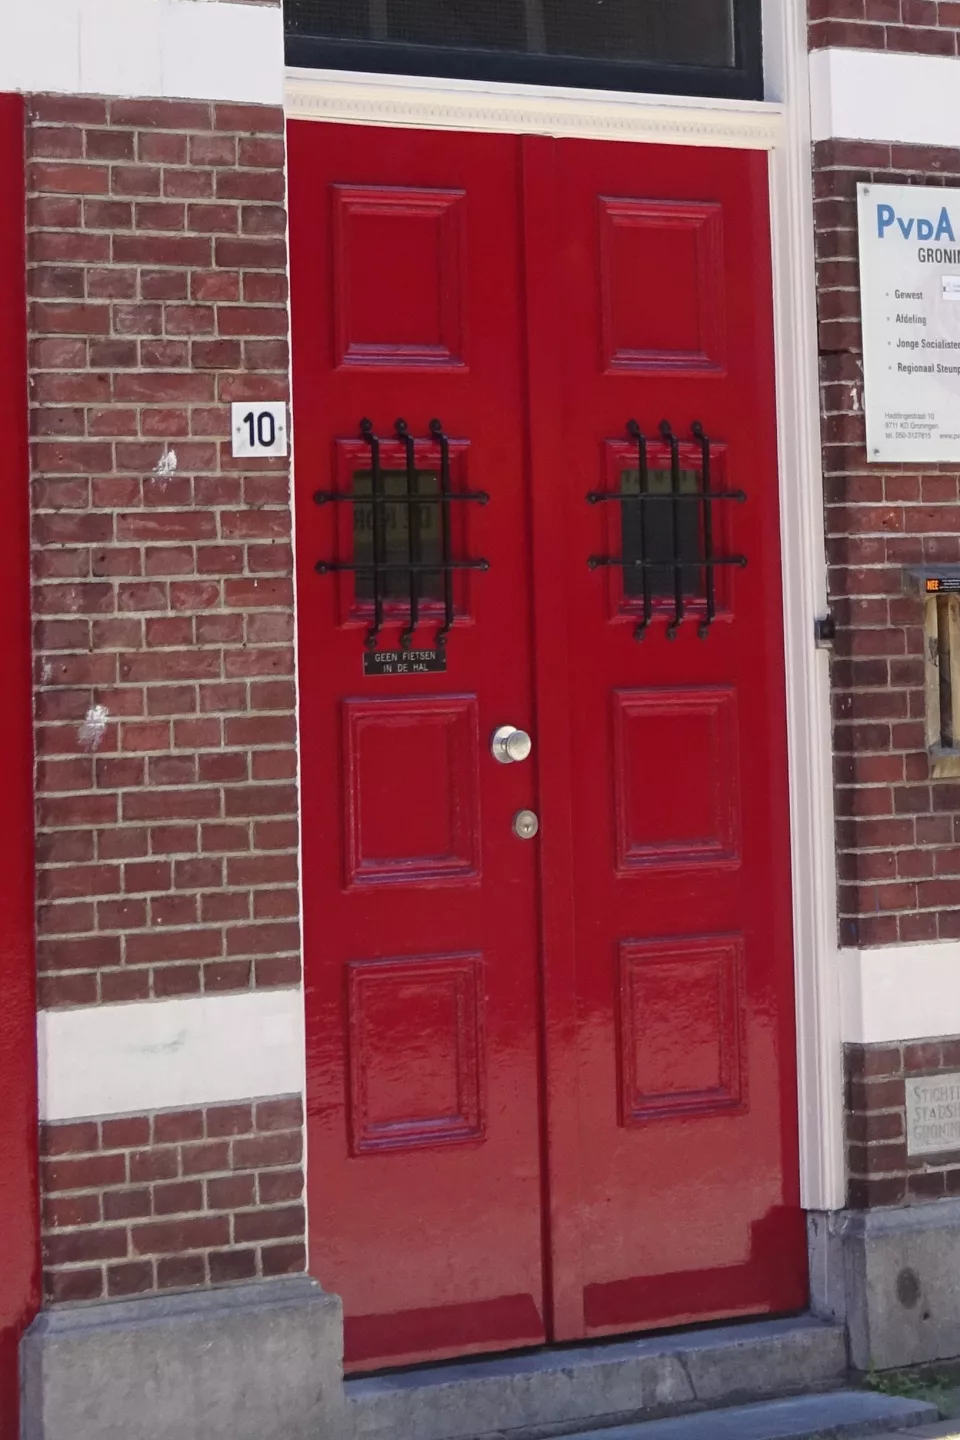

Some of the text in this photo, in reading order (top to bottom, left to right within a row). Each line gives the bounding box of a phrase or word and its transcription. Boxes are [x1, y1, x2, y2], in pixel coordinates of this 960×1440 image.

[895, 290, 923, 300] Gewest
[896, 314, 926, 326] Afdeling
[897, 339, 919, 350] Jonge
[898, 364, 934, 375] Regionaal
[243, 411, 275, 447] 10
[910, 423, 939, 431] Groningen
[927, 580, 938, 590] NEE
[375, 651, 436, 662] GEEN FIETSEN
[397, 663, 408, 672] DE
[413, 663, 428, 671] HAL
